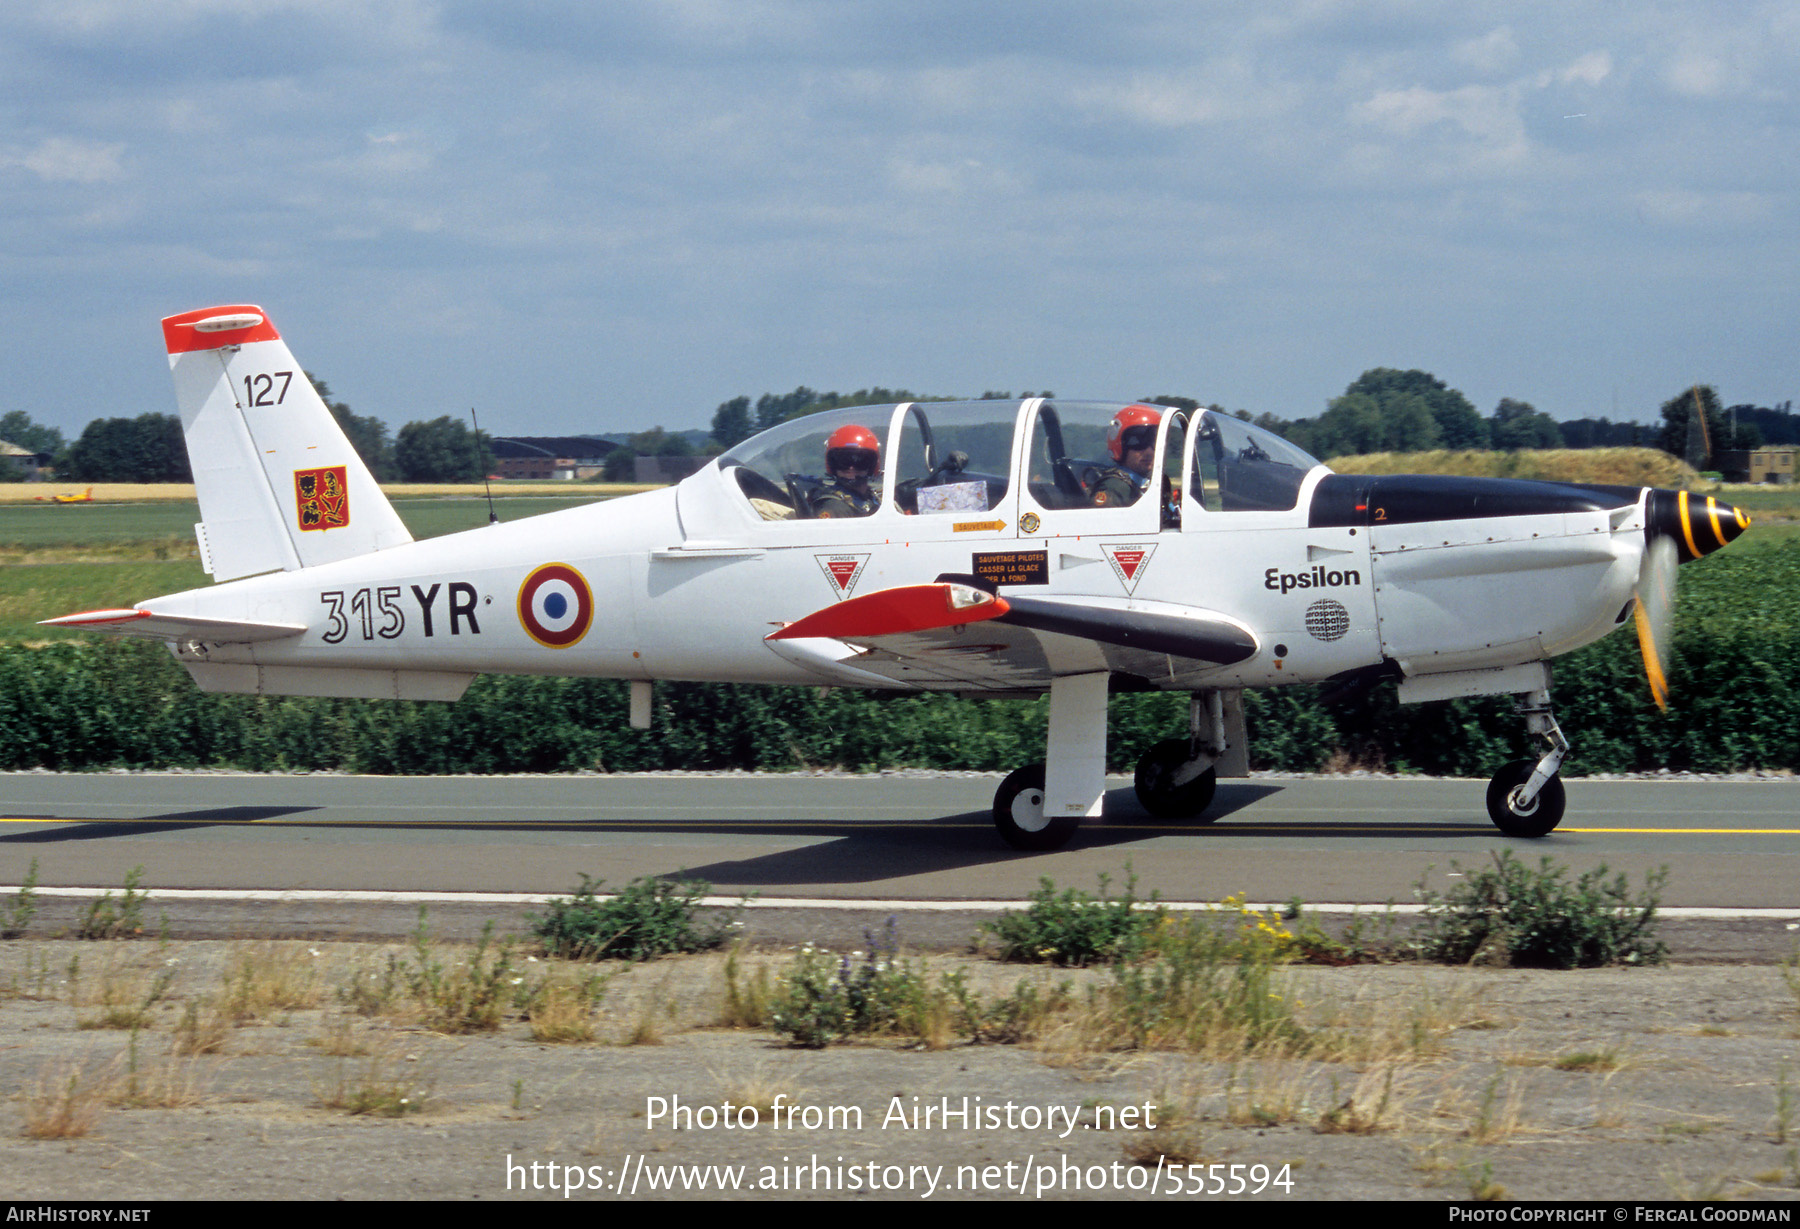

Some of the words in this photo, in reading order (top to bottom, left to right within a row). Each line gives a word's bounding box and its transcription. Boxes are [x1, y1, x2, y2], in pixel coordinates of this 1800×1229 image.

[244, 371, 293, 407] 127
[1375, 507, 1387, 520] 2
[959, 522, 996, 531] SAUVETAGE
[1018, 553, 1045, 562] PILOTES
[1007, 564, 1016, 572] LA
[1018, 564, 1039, 572] GLACE
[1264, 565, 1361, 595] Epsilon
